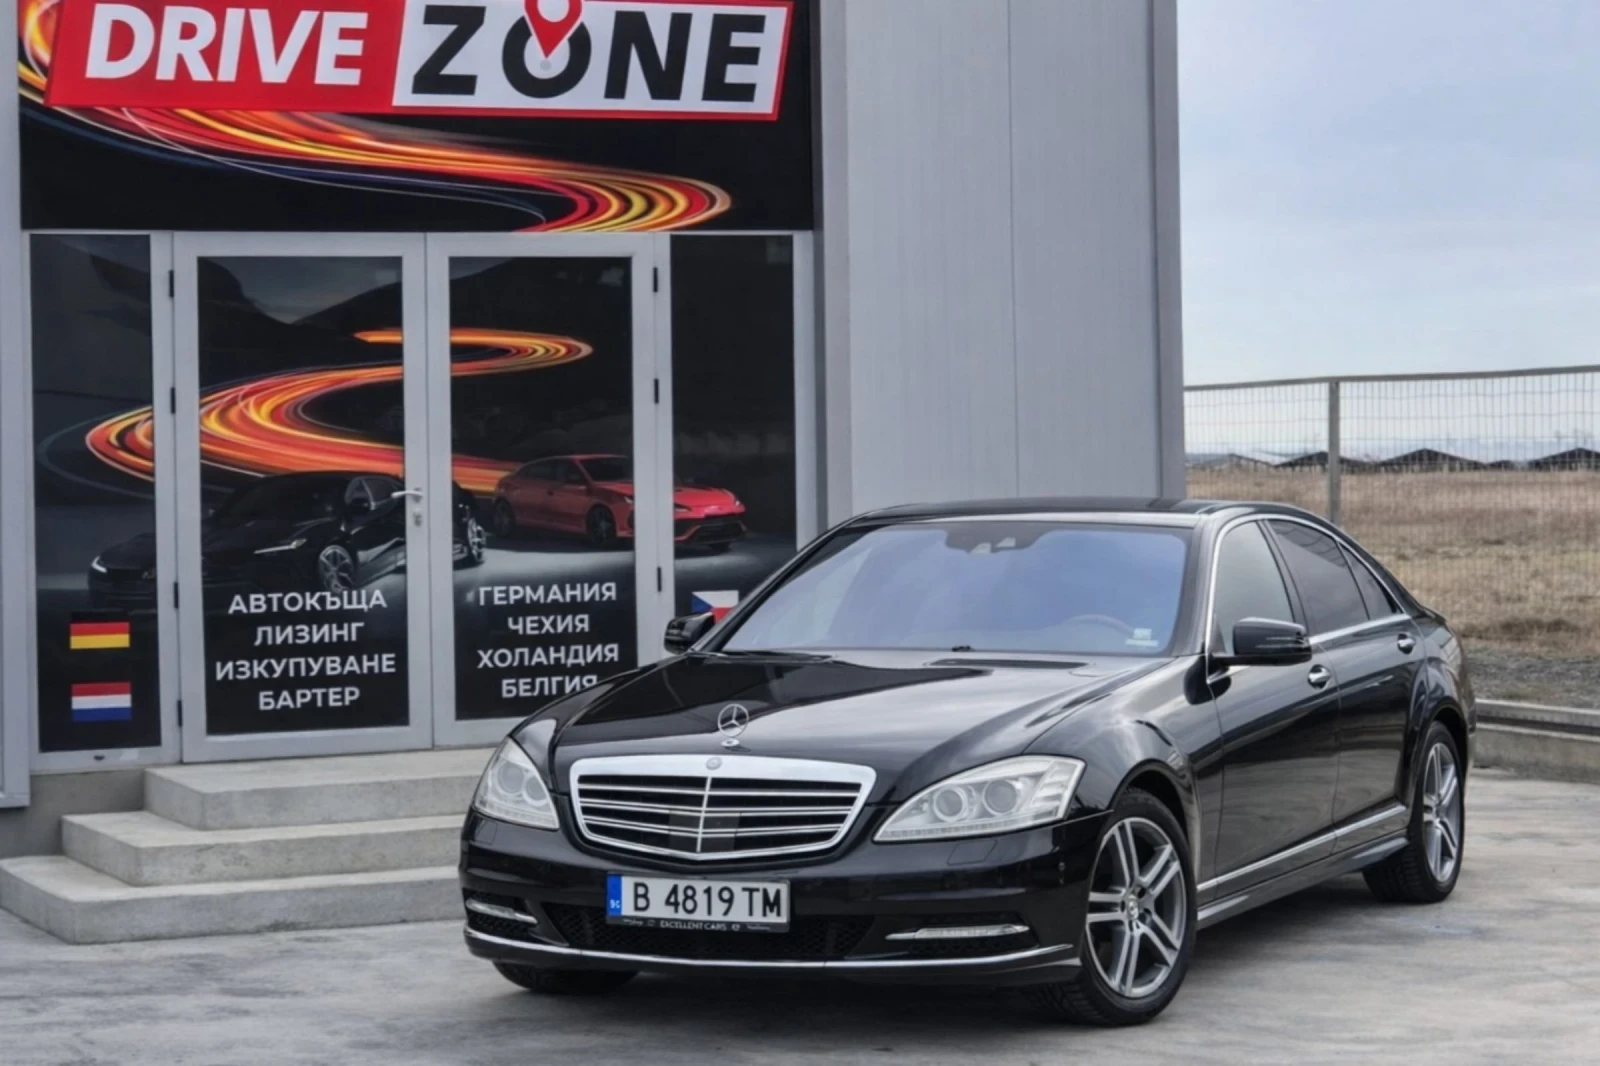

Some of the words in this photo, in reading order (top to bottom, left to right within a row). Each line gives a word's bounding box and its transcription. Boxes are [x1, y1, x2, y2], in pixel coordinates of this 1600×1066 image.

[85, 3, 368, 85] DRIVE
[411, 4, 766, 102] ZONE
[228, 588, 388, 615] АВТОКЪЩА
[478, 582, 617, 606] ГЕРМАНИЯ
[254, 621, 365, 646] ЛИЗИНГ
[507, 614, 590, 635] ЧЕХИЯ
[215, 653, 397, 681] ИЗКУПУВАНЕ
[476, 643, 620, 669] ХОЛАНДИЯ
[258, 686, 361, 711] БАРТЕР
[664, 884, 735, 917] 4819
[741, 887, 782, 917] TM
